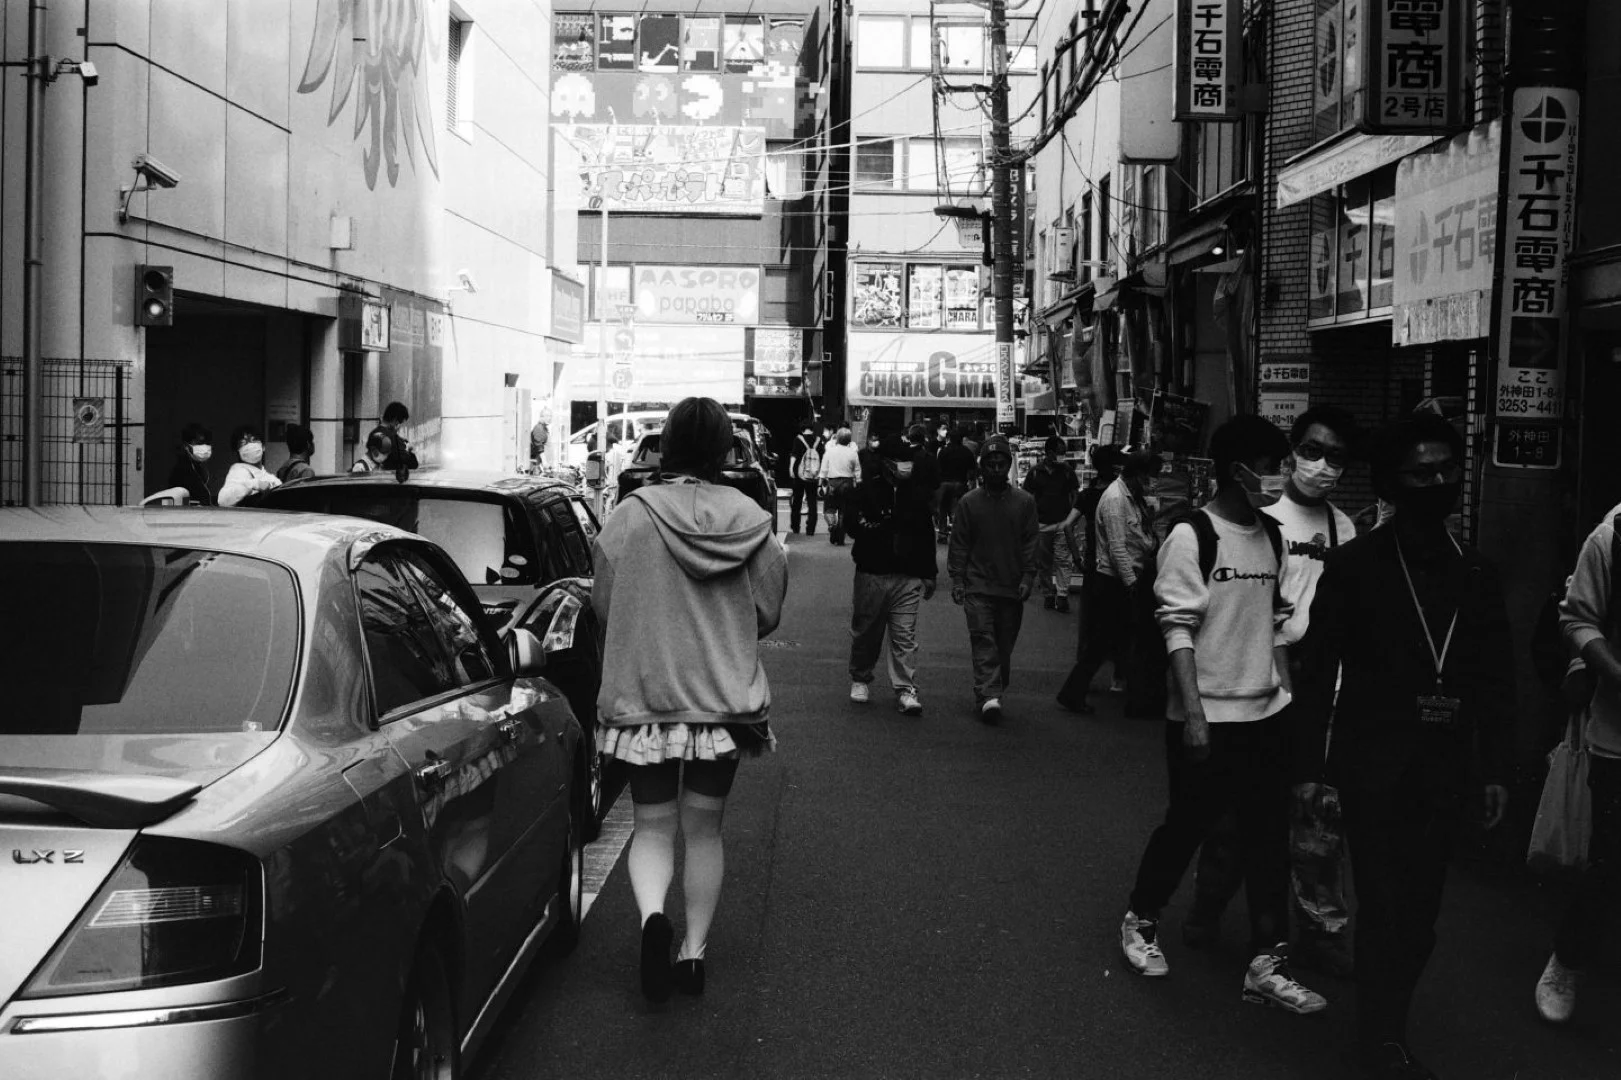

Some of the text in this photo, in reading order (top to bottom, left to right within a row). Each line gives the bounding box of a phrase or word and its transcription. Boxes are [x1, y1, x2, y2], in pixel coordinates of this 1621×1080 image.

[1193, 4, 1223, 107] 千石電商
[1384, 96, 1446, 118] 2号店
[1512, 154, 1565, 314] 千石電商
[860, 372, 927, 397] CHARA
[928, 351, 957, 398] G
[1518, 370, 1549, 384] ここ
[1508, 429, 1550, 444] 外神田
